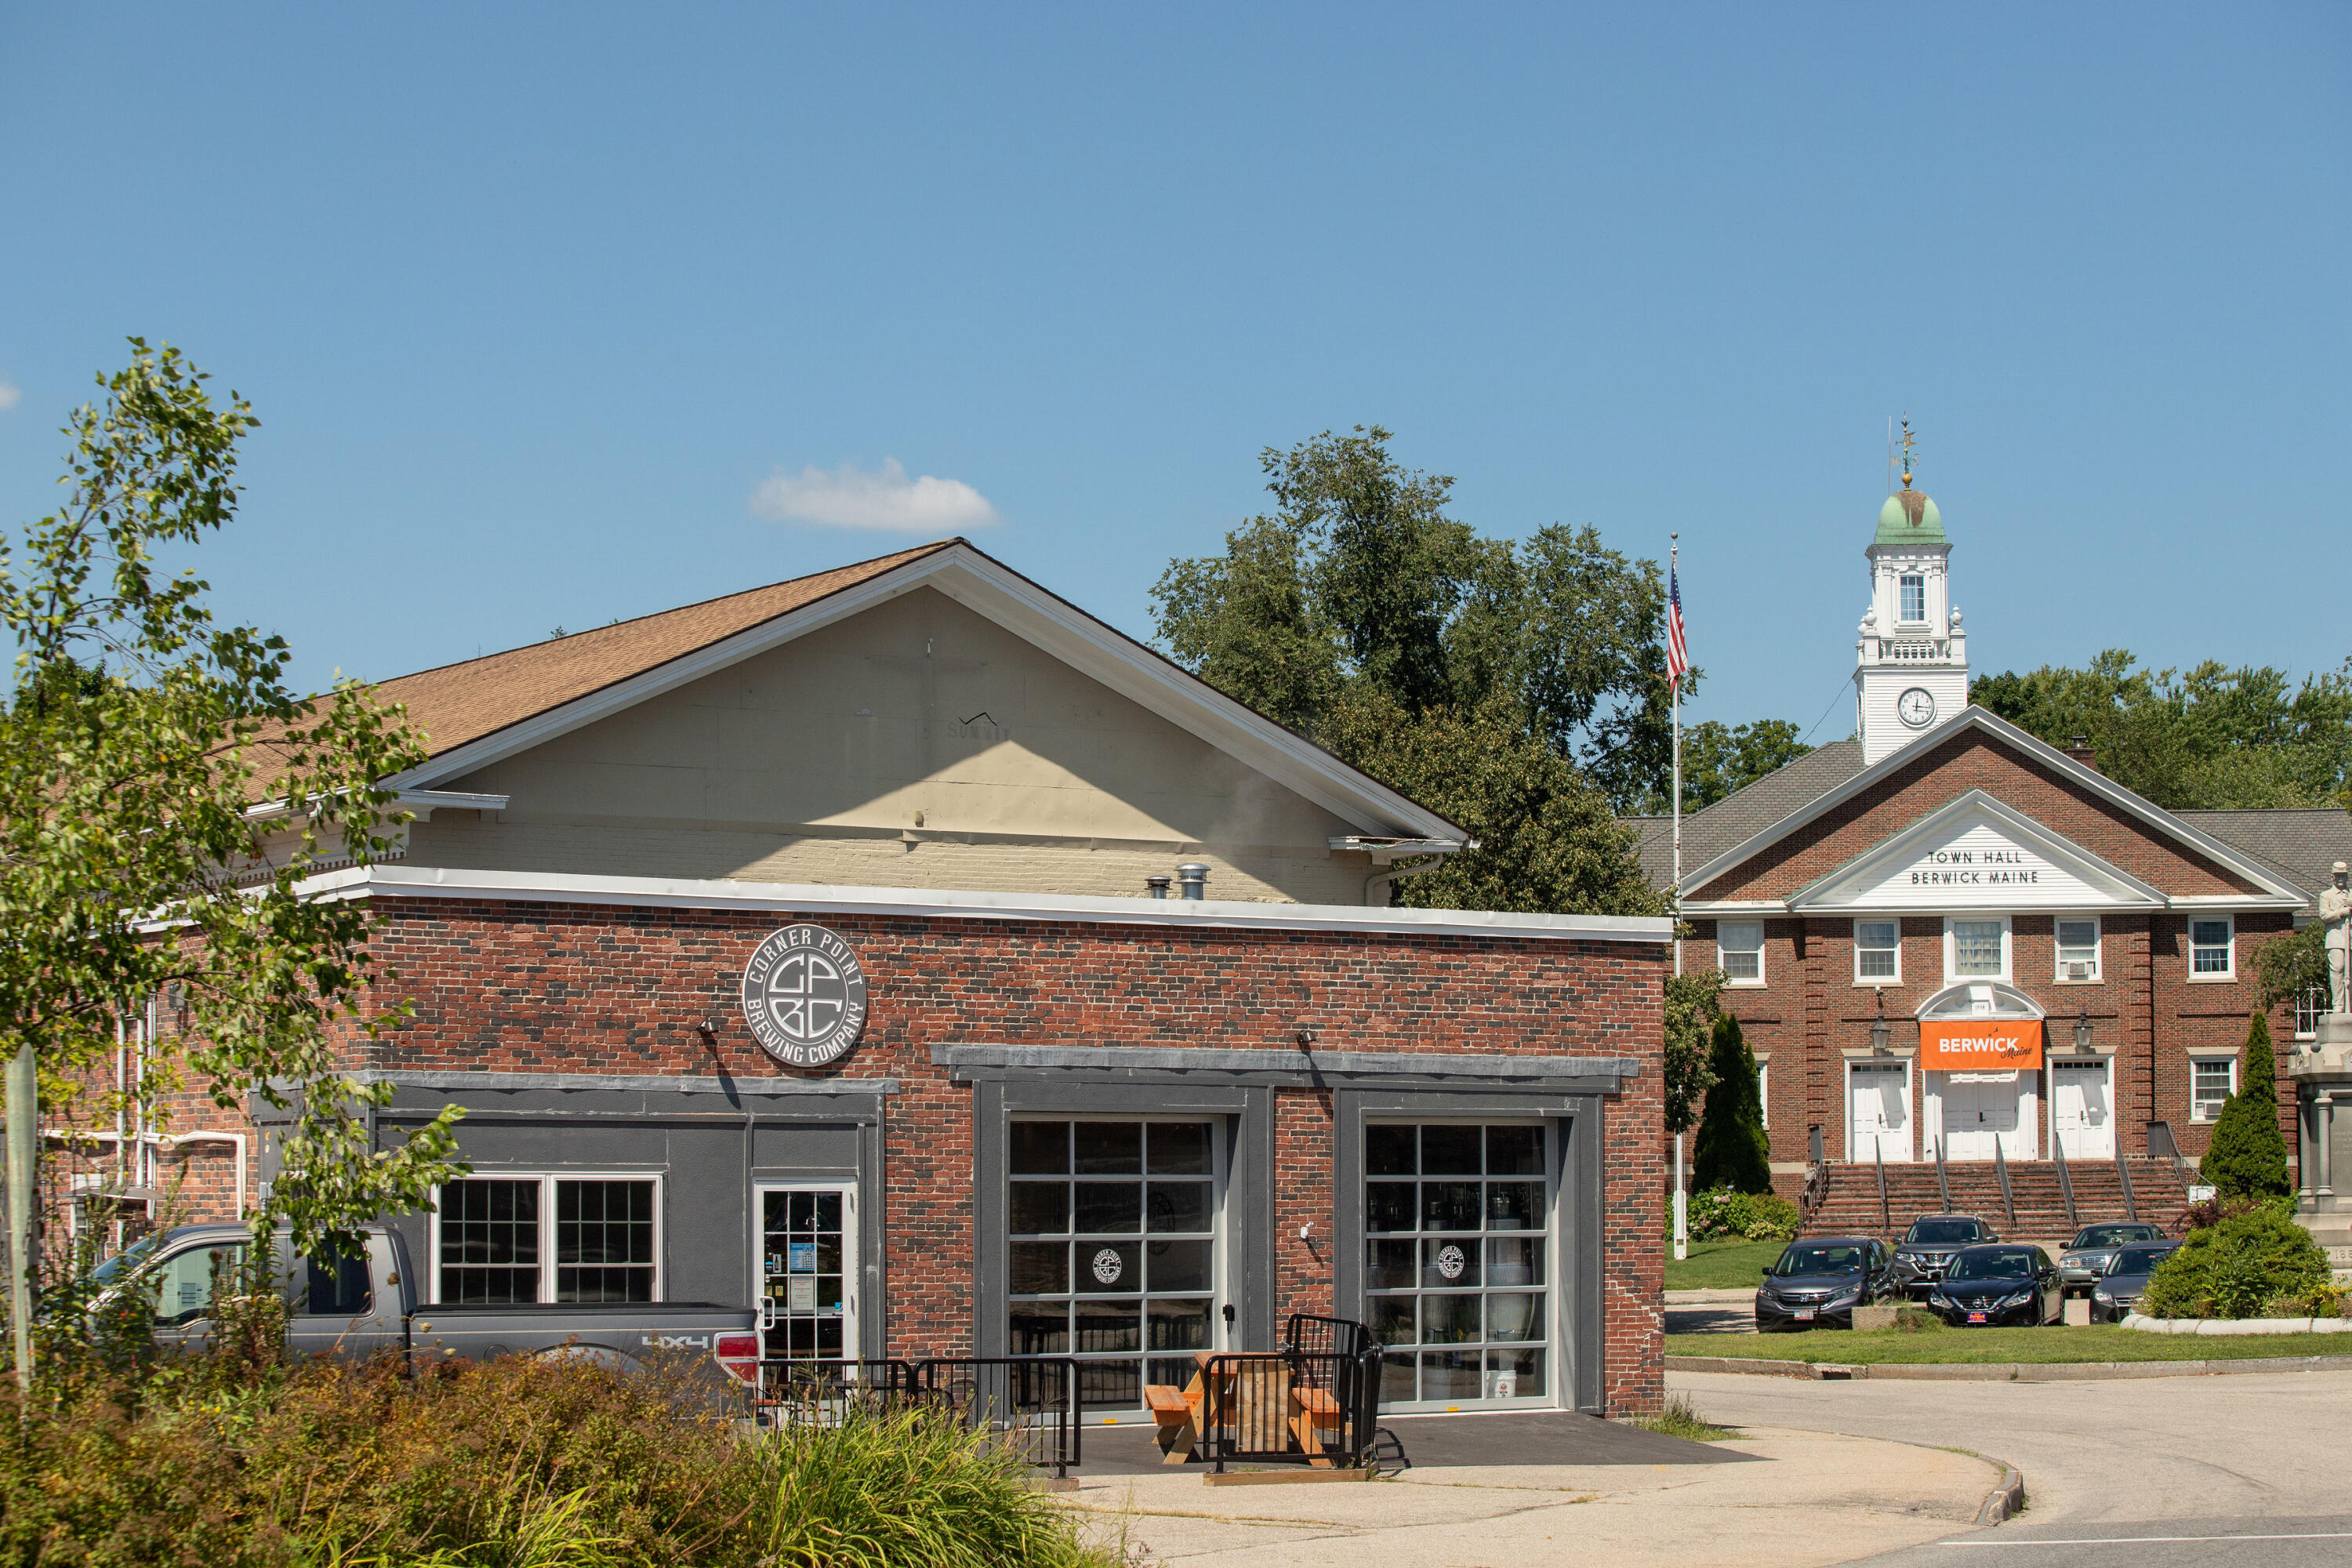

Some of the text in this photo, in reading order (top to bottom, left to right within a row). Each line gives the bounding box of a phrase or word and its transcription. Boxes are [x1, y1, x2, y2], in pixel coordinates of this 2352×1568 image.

[1928, 851, 2021, 863] TOWN HALL
[1912, 871, 2038, 884] BERWICK MAINE
[750, 928, 863, 985] CORNER POINT
[746, 997, 863, 1063] BREWING COMPANY
[1939, 1037, 2019, 1052] BERWICK
[2001, 1047, 2033, 1059] Maine
[642, 1336, 709, 1348] 4X4
